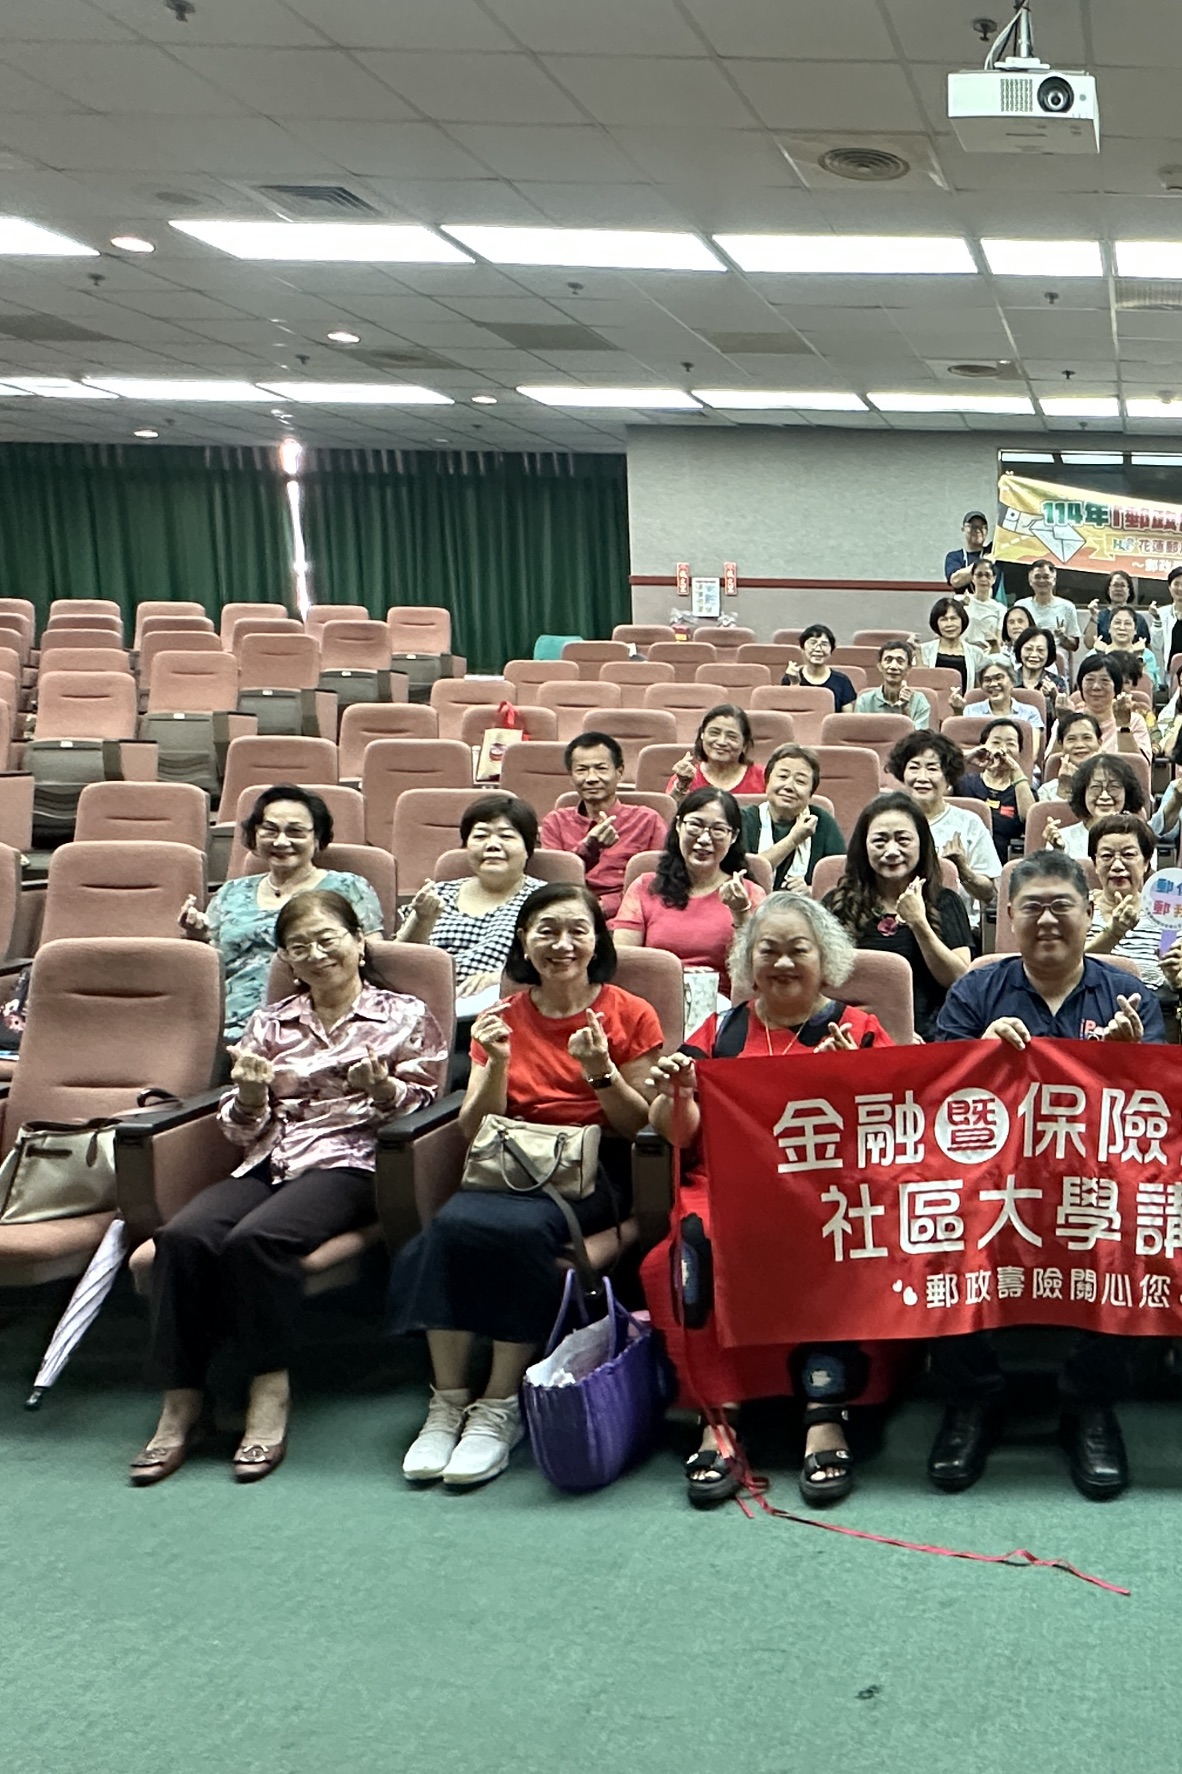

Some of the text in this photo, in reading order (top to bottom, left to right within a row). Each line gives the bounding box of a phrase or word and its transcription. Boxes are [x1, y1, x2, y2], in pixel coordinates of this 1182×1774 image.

[926, 1266, 1171, 1309] 郵政壽險關心您
